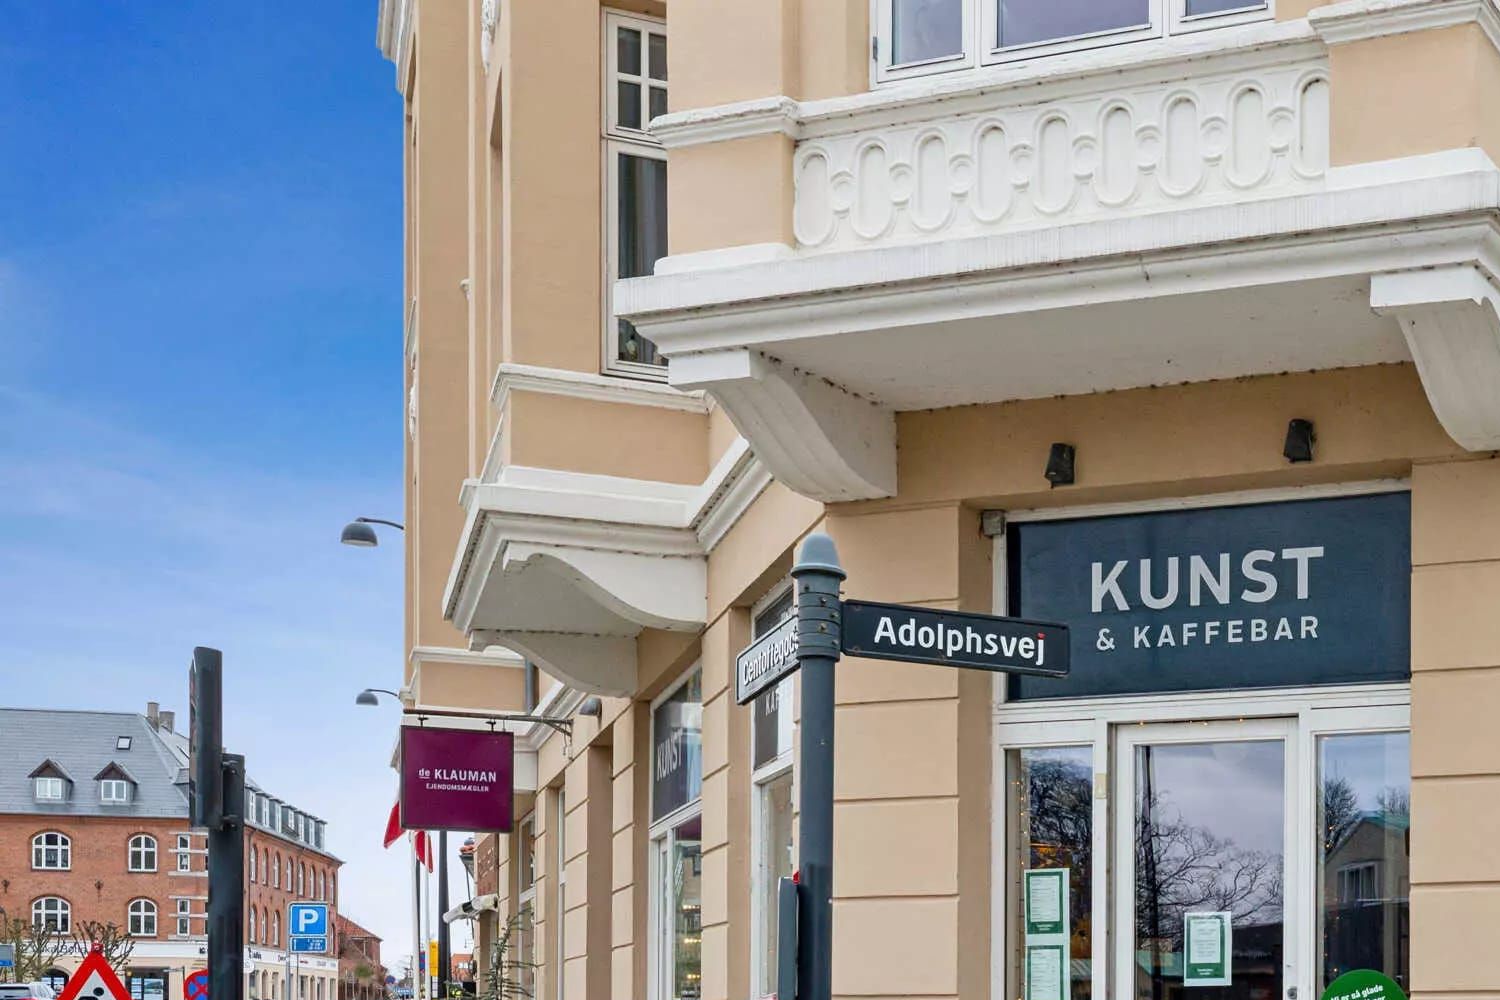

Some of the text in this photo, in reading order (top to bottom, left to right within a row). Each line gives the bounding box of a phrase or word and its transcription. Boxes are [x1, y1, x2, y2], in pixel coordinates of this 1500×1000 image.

[1091, 546, 1324, 613] KUNST
[874, 616, 1046, 666] Adolphsvej
[1096, 615, 1319, 651] & KAFFEBAR
[656, 728, 683, 782] KUNST
[425, 782, 490, 793] EJENDOMSMÆGLER
[434, 768, 497, 783] KLAUMAN
[299, 908, 319, 932] P
[1351, 989, 1361, 999] så
[1362, 984, 1383, 997] glade
